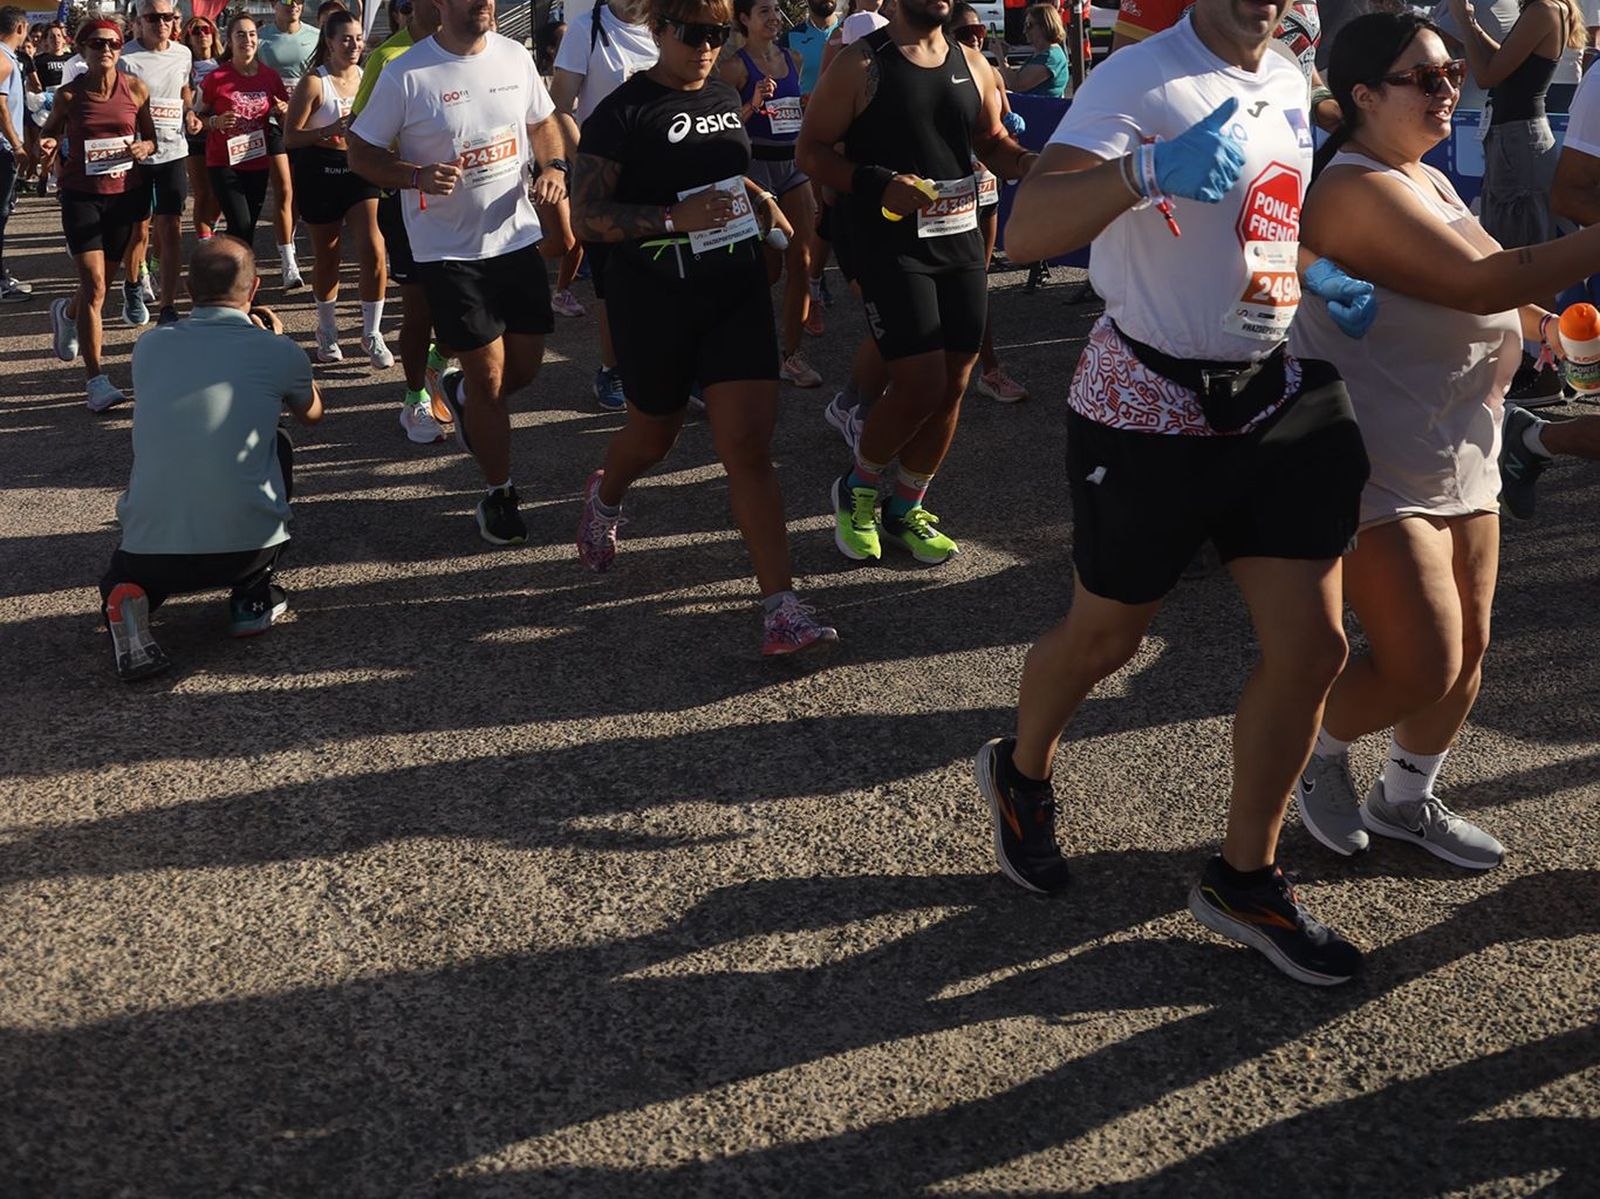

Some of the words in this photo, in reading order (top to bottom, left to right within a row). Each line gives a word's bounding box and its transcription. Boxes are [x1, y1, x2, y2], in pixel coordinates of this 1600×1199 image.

[695, 111, 741, 134] asics
[466, 140, 513, 167] 24377
[1254, 191, 1298, 226] PONLE
